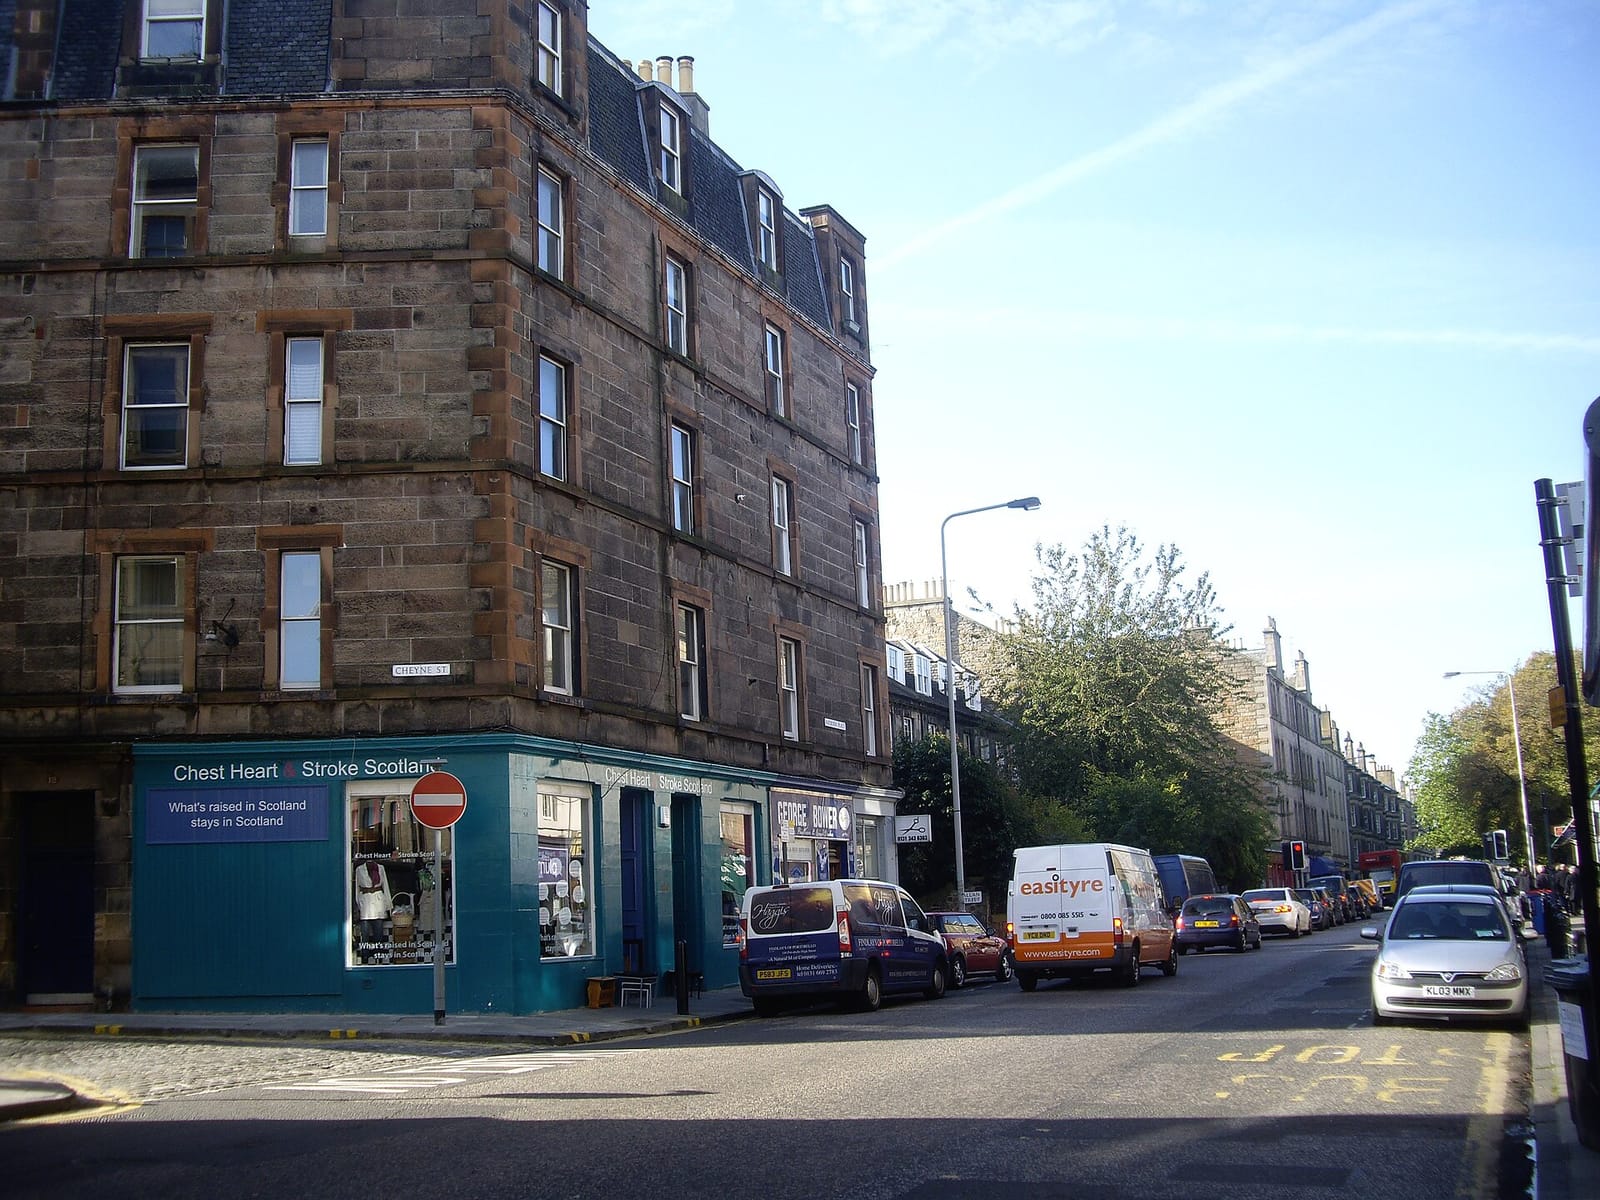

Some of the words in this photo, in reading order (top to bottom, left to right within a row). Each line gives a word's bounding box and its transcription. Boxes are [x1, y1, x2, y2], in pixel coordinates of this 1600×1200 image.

[395, 666, 432, 674] CHEYNE
[436, 665, 447, 674] ST
[174, 765, 224, 780] Chest
[230, 764, 278, 779] Heart
[302, 760, 358, 777] Stroke
[630, 771, 651, 787] Heart
[660, 776, 682, 791] Stroke
[168, 802, 206, 813] What's
[209, 801, 242, 812] raised
[246, 801, 255, 811] in
[258, 800, 306, 811] Scotland
[778, 801, 807, 827] GEORGE
[812, 804, 838, 830] BOWER
[190, 818, 220, 829] stays
[222, 817, 232, 827] in
[236, 816, 284, 827] Scotland
[398, 850, 419, 858] Stroke
[1020, 875, 1103, 898] easityre
[1040, 912, 1056, 920] 0800
[1024, 949, 1100, 958] www.easityre.com
[1427, 987, 1450, 996] KL03
